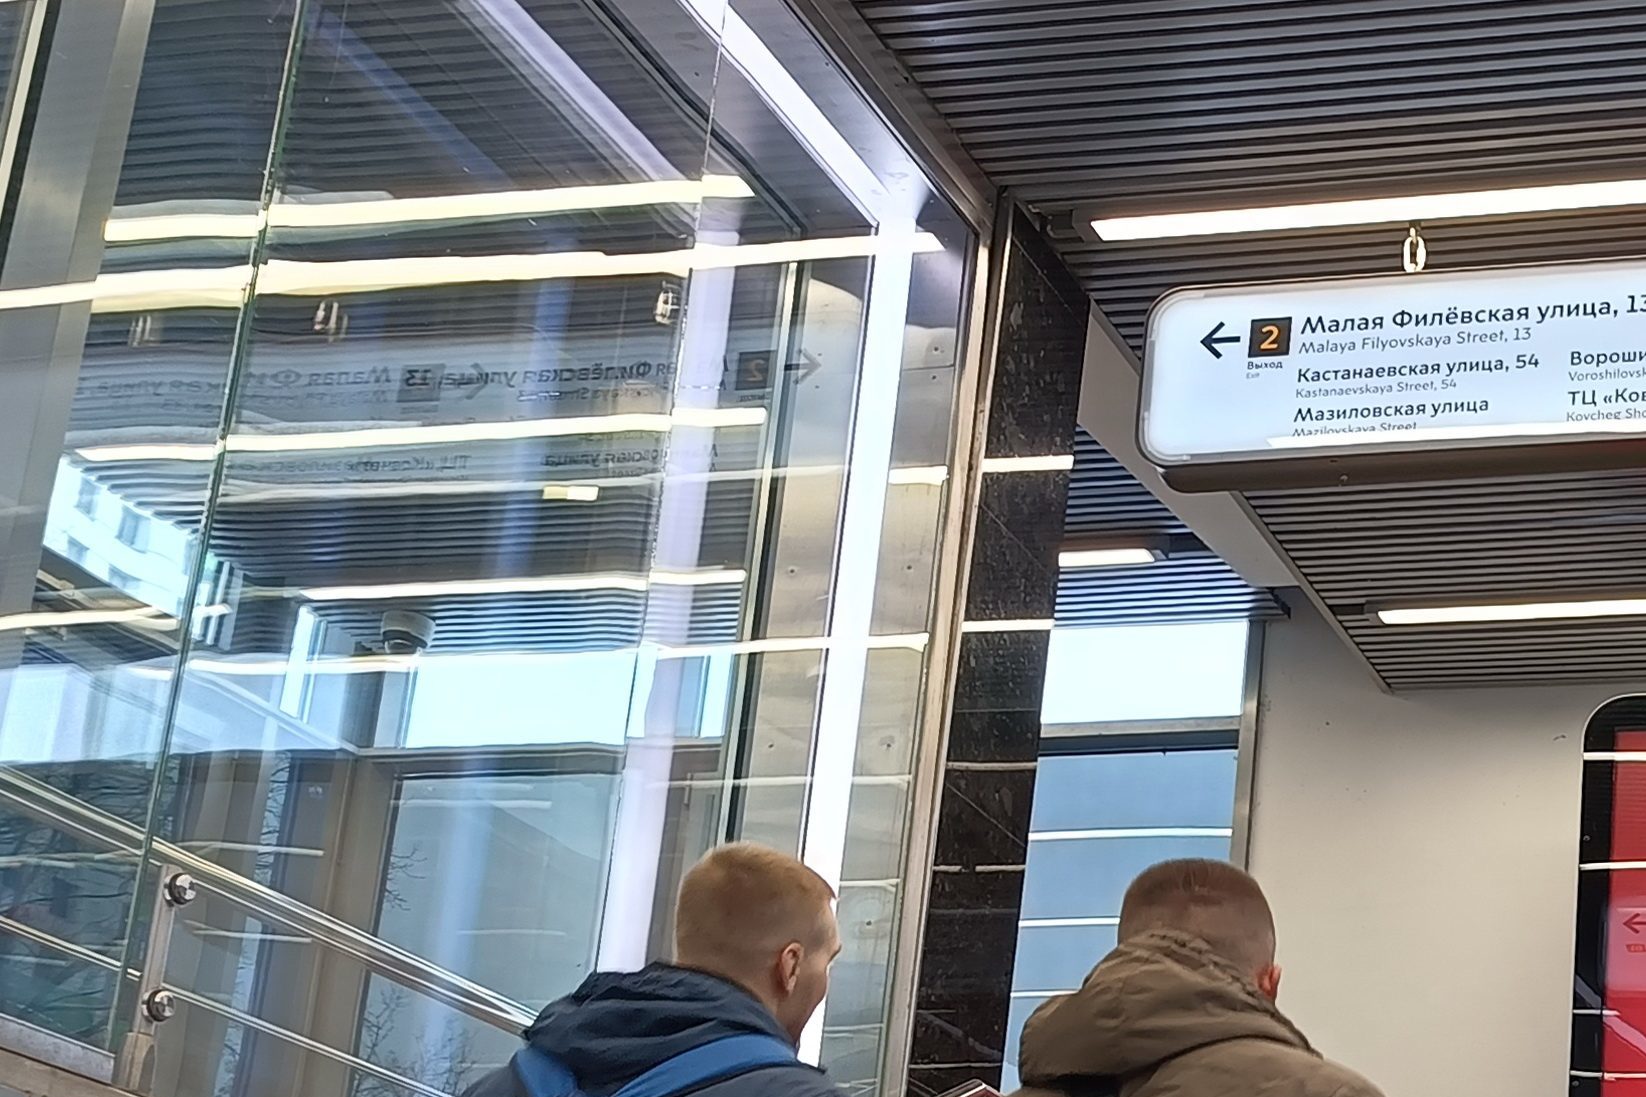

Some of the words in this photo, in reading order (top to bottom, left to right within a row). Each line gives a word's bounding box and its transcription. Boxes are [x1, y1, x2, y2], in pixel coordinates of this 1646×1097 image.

[1300, 314, 1384, 336] Малая
[1392, 304, 1529, 329] Филёвская
[1536, 299, 1618, 324] улица,
[1259, 325, 1278, 350] 2
[1298, 337, 1357, 355] Malaya
[1362, 332, 1450, 352] Filyovskaya
[1456, 328, 1508, 345] Street,
[1512, 327, 1532, 341] 13
[1247, 360, 1282, 370] Выход
[1297, 364, 1441, 383] Кастанаевская
[1446, 357, 1510, 377] улица,
[1515, 354, 1539, 368] 54
[1296, 382, 1393, 398] Kastanaevskaya
[1397, 380, 1438, 393] Street,
[1441, 379, 1457, 390] 54
[1567, 390, 1597, 407] ТЦ
[1293, 404, 1425, 423] Мазиловская
[1430, 399, 1489, 417] улица
[1566, 410, 1622, 422] Kovcheg
